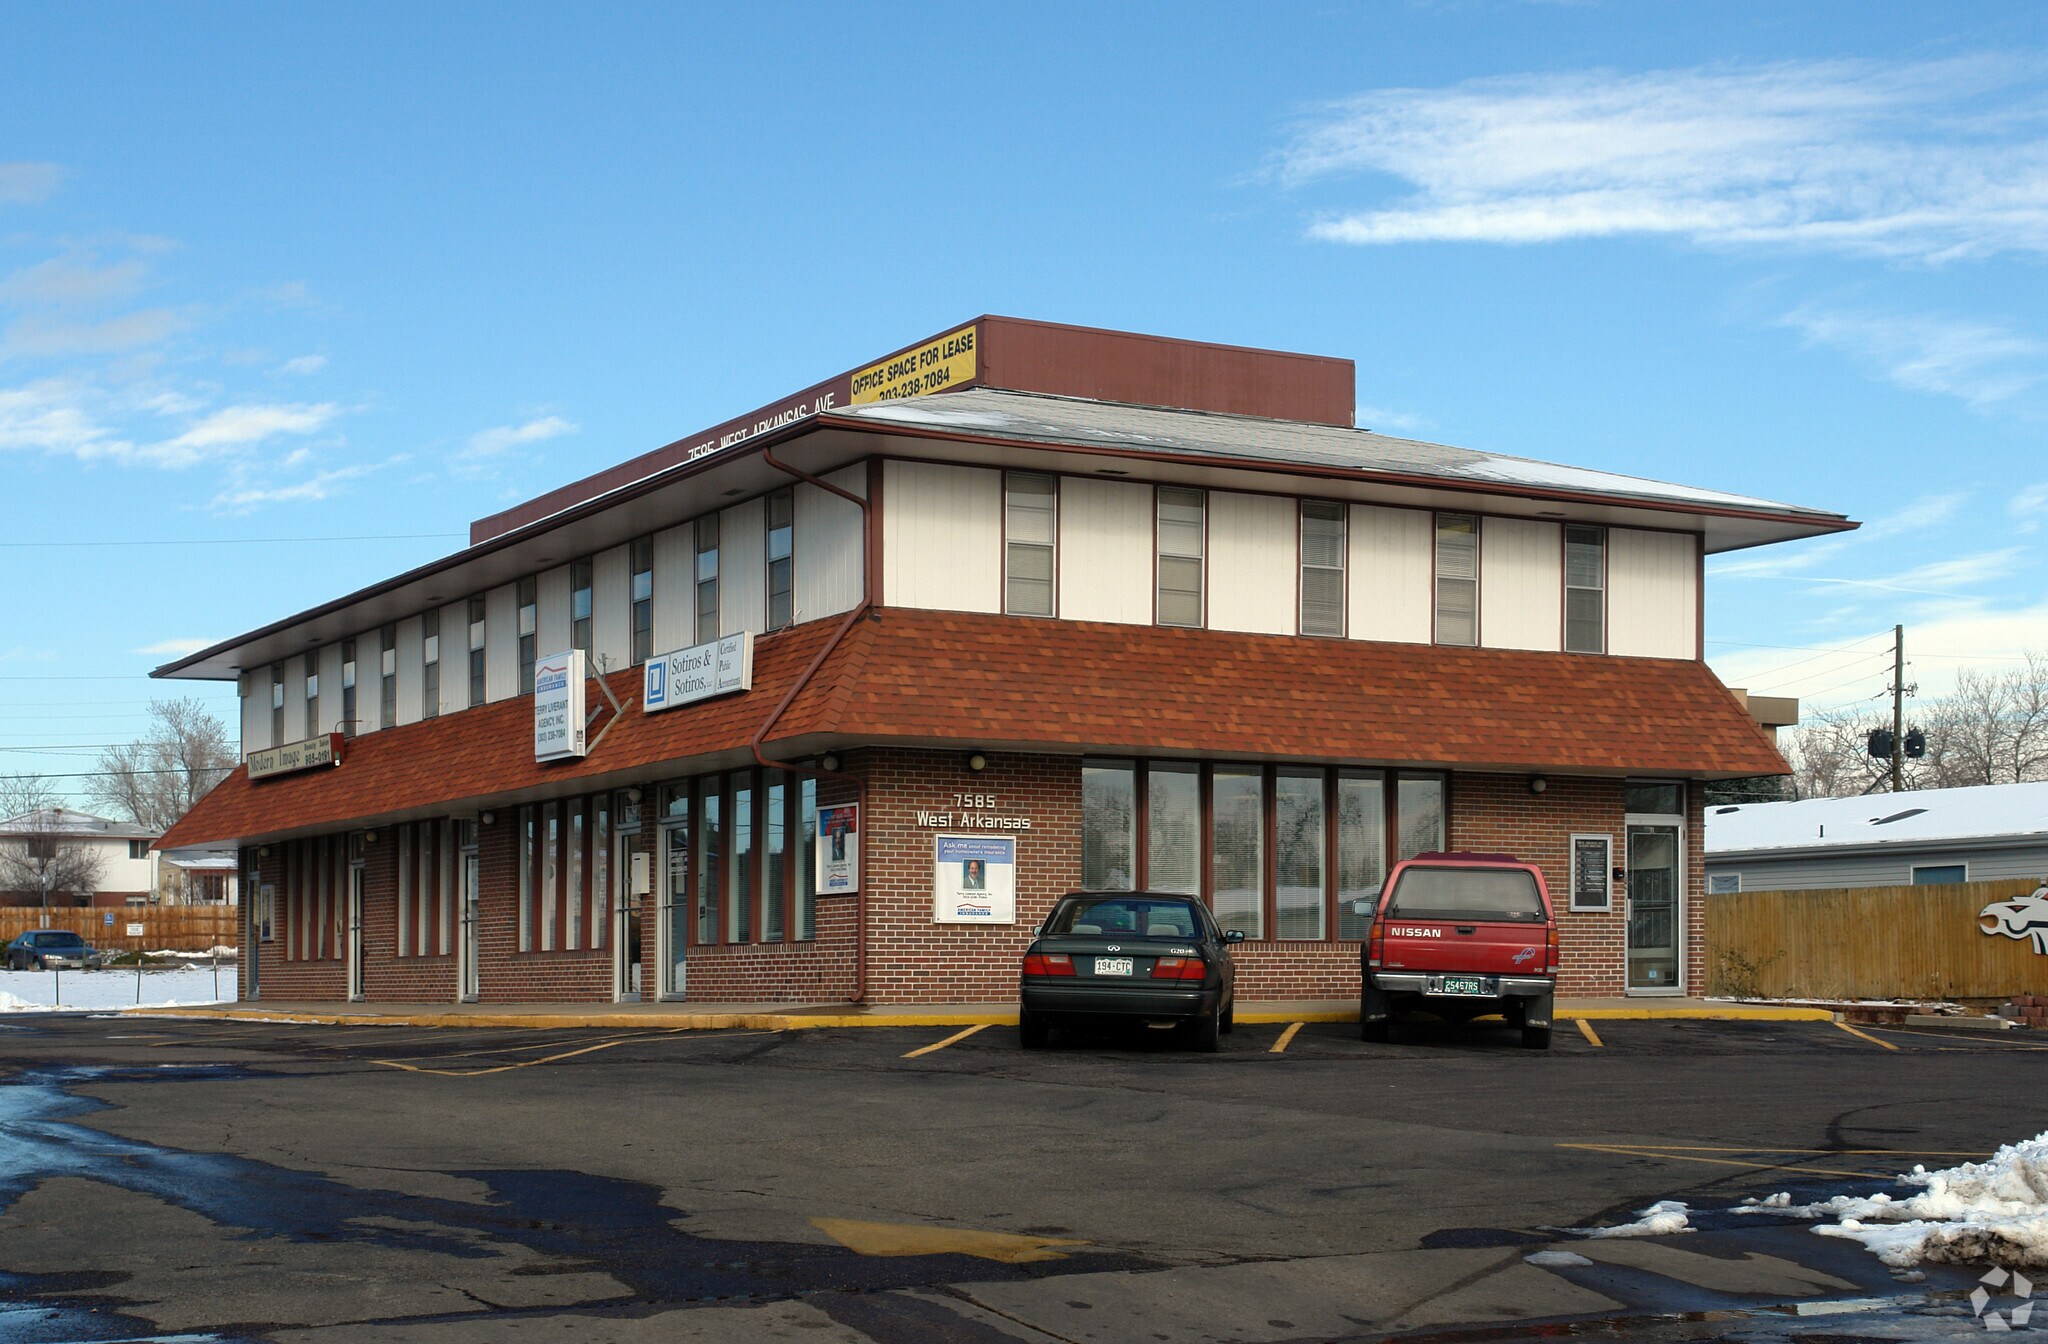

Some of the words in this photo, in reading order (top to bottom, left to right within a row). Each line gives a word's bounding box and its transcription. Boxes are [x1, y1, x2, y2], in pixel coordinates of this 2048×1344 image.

[852, 368, 884, 396] OFFICE
[887, 355, 917, 382] SPACE
[919, 346, 939, 370] FOR
[942, 332, 974, 360] LEASE
[814, 391, 835, 413] AVE
[671, 654, 702, 676] Sotiros
[703, 649, 712, 667] &
[674, 675, 707, 696] Sotiros,
[249, 753, 274, 773] Modern
[278, 749, 300, 768] Image
[953, 794, 996, 808] 7585
[916, 810, 953, 828] West
[960, 811, 1031, 830] Arkansas
[1391, 927, 1442, 938] NISSAN
